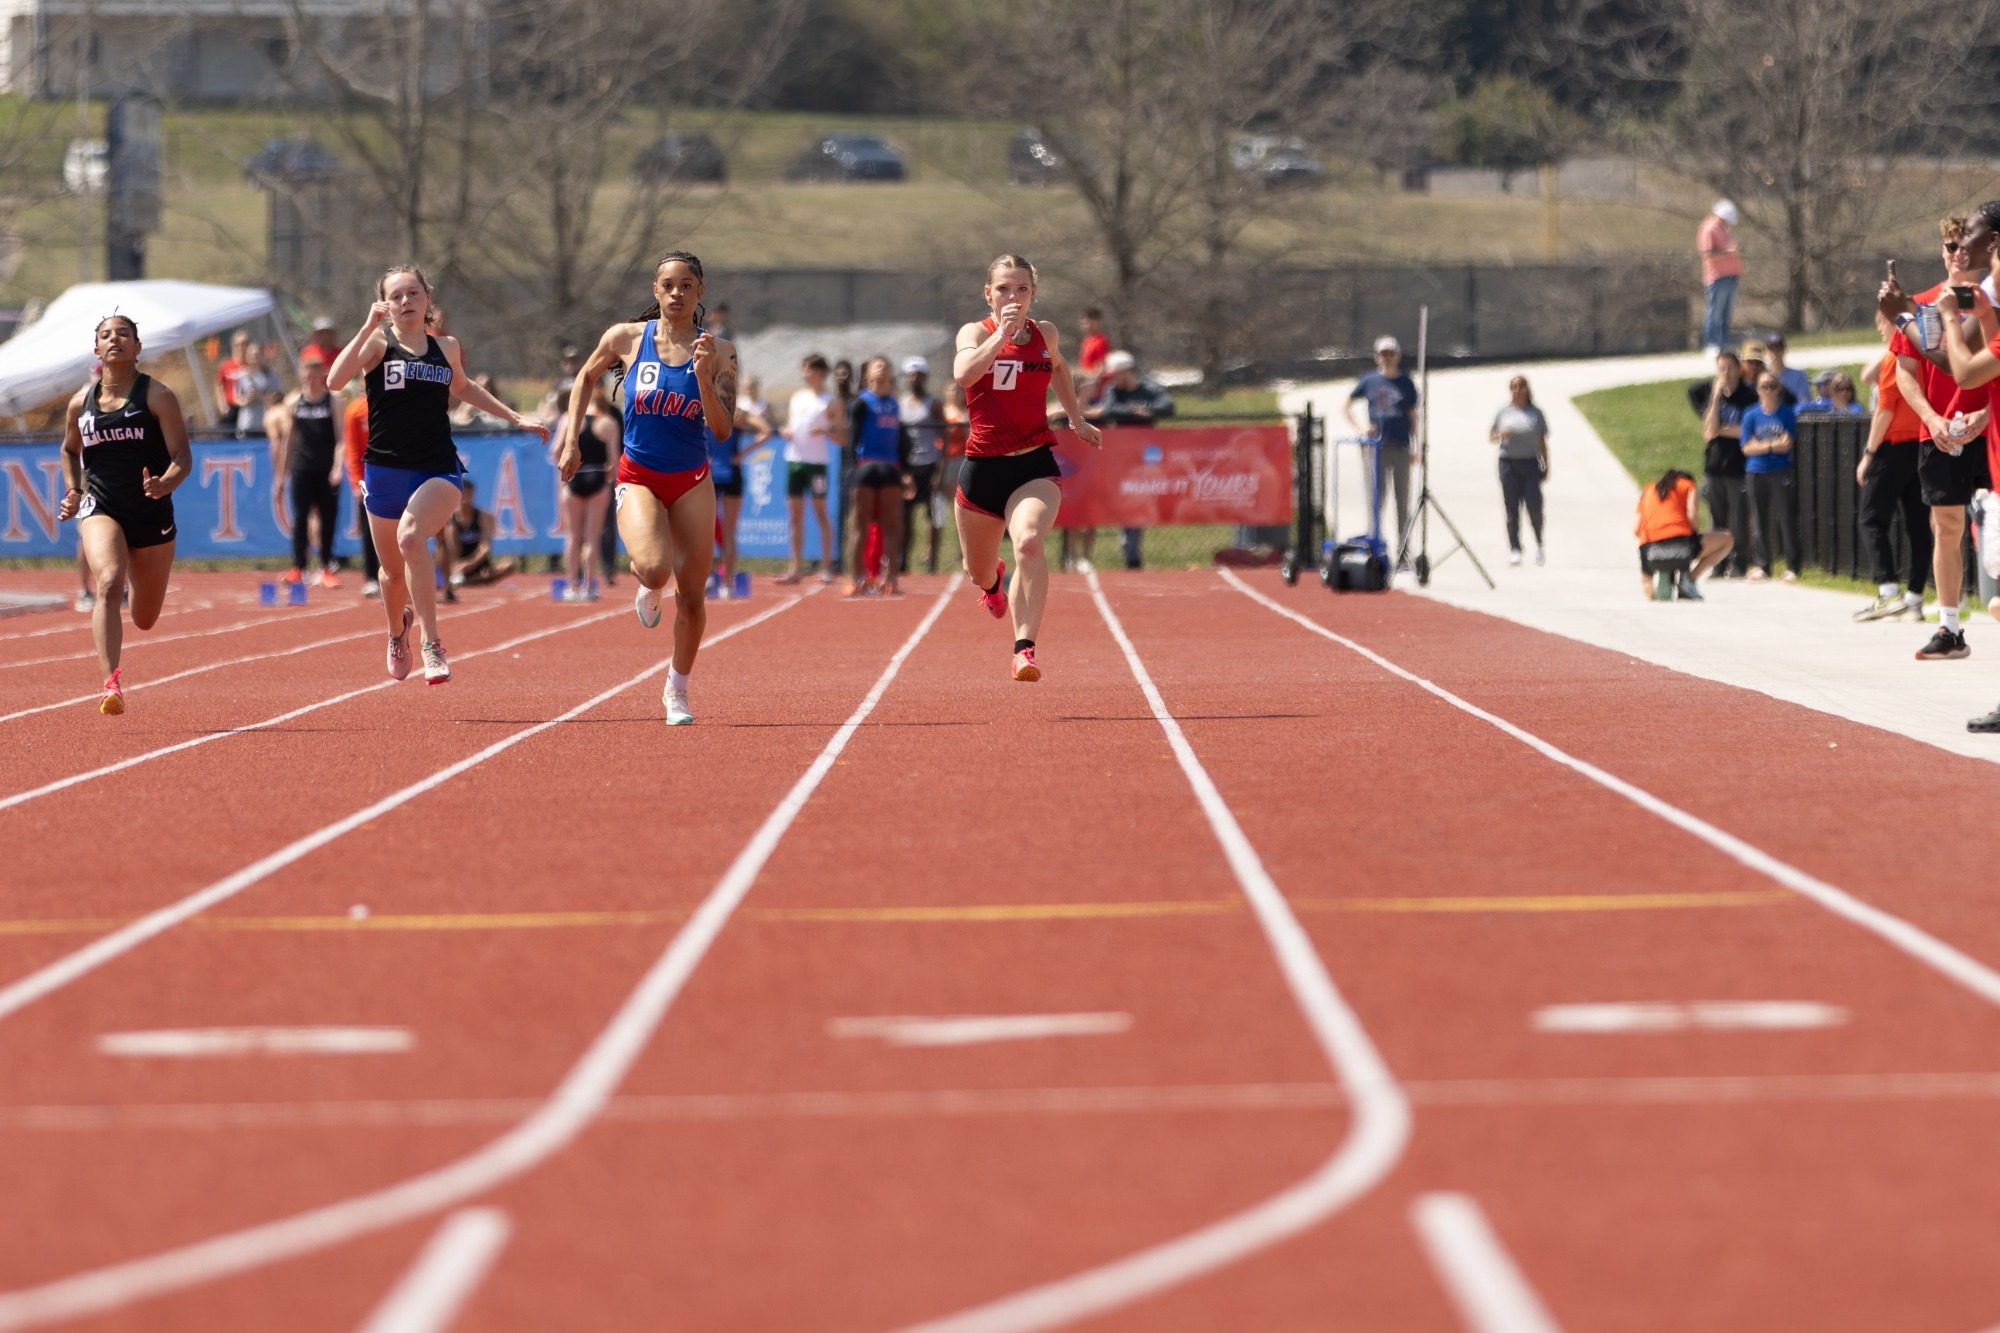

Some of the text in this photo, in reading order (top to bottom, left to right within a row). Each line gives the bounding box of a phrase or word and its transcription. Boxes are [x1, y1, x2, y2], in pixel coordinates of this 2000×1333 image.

[386, 364, 402, 385] 5
[404, 362, 452, 385] EVARD
[639, 364, 657, 385] 6
[997, 363, 1015, 385] 7
[82, 419, 95, 441] 4
[95, 427, 144, 443] LLIGAN
